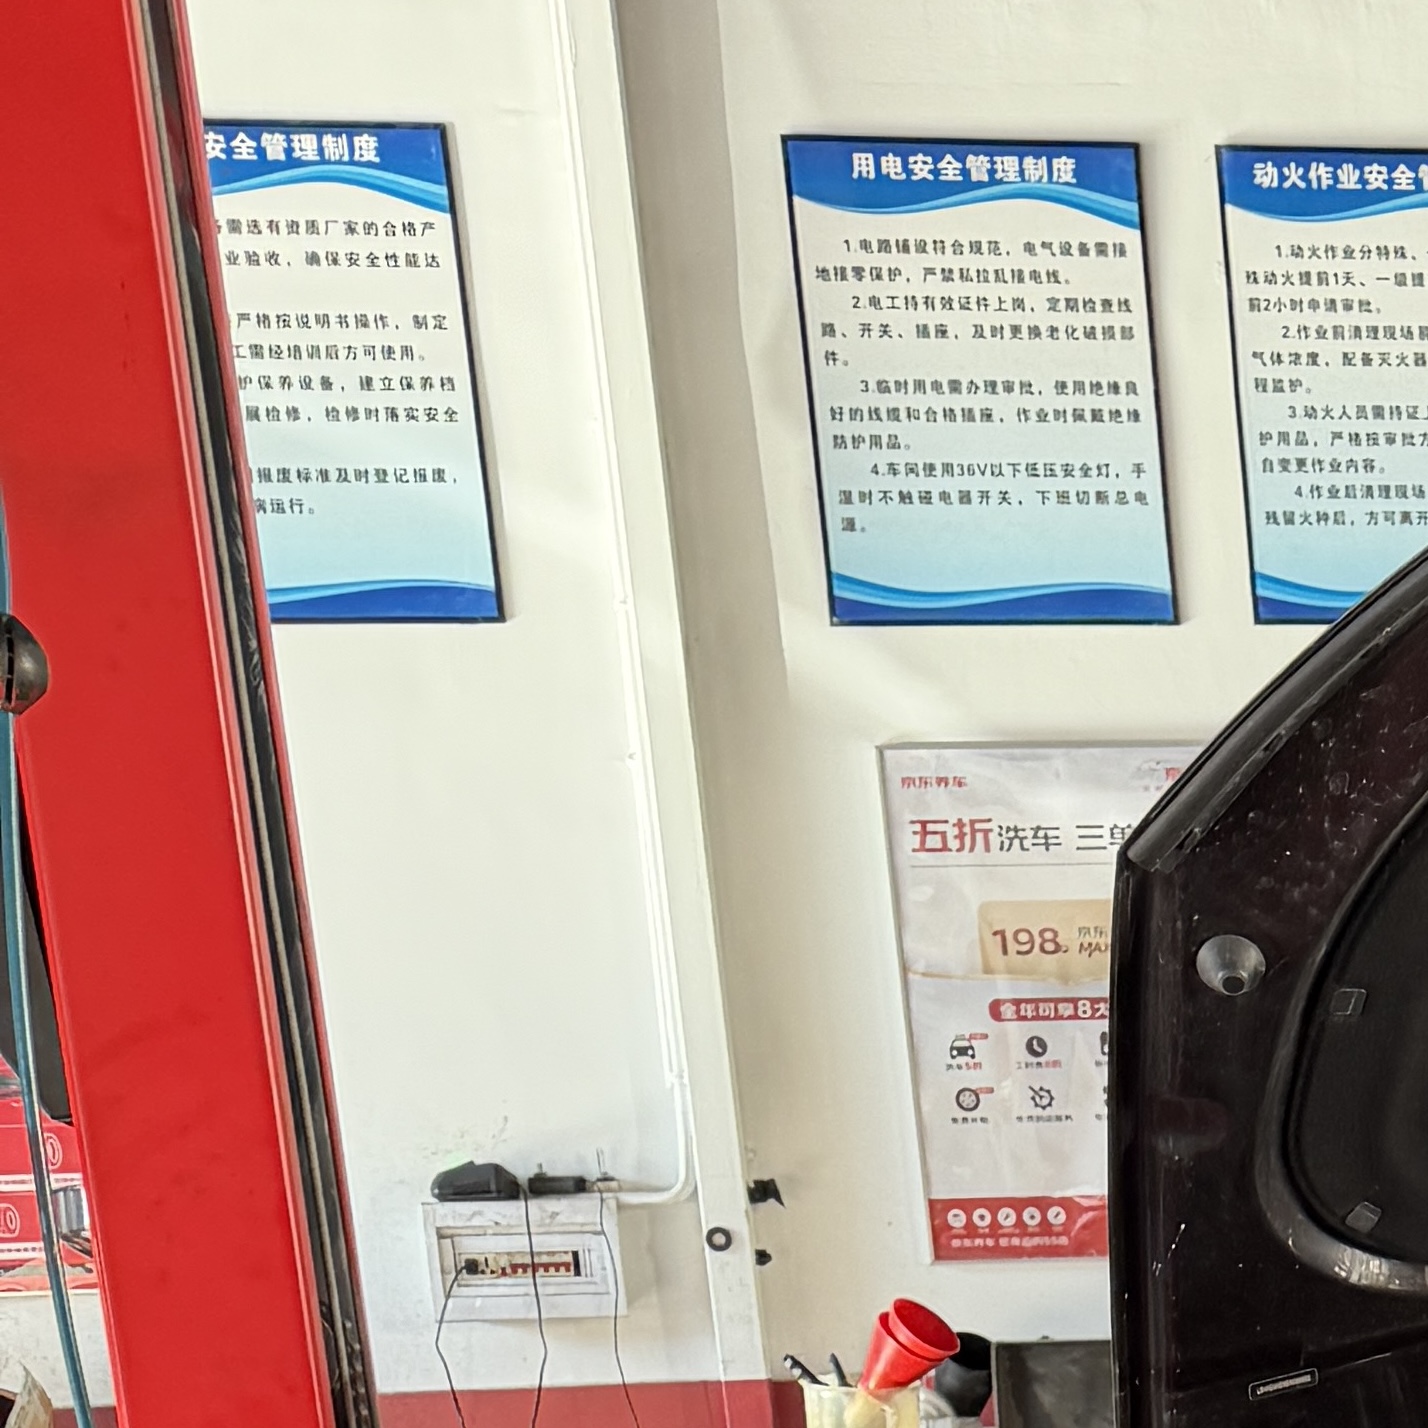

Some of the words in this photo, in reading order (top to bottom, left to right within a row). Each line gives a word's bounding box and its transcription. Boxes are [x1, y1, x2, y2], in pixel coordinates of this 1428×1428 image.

[204, 131, 380, 163] 安全管理制度
[851, 152, 1077, 184] 用电安全管理制度
[251, 466, 457, 485] 报废标准及时登记报废，
[909, 818, 1062, 853] 五折洗车
